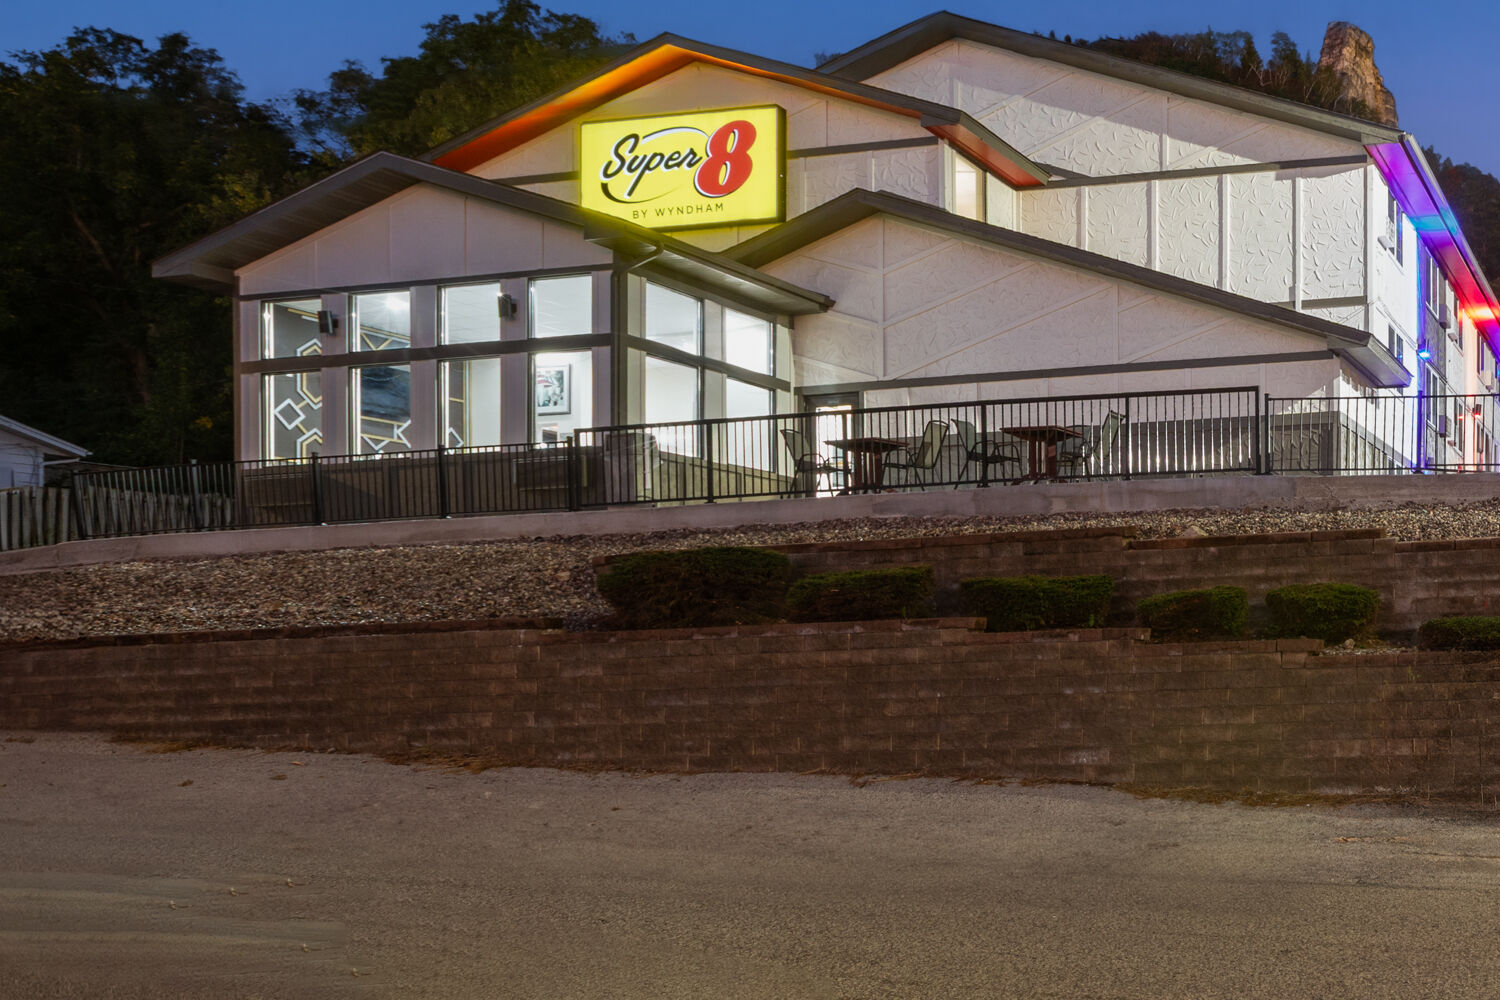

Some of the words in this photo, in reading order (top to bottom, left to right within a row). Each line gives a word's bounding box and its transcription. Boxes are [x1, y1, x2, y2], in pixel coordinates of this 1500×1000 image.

[601, 133, 703, 198] Super
[694, 120, 757, 198] 8
[632, 208, 648, 219] BY
[655, 203, 724, 217] WYNDHAM
